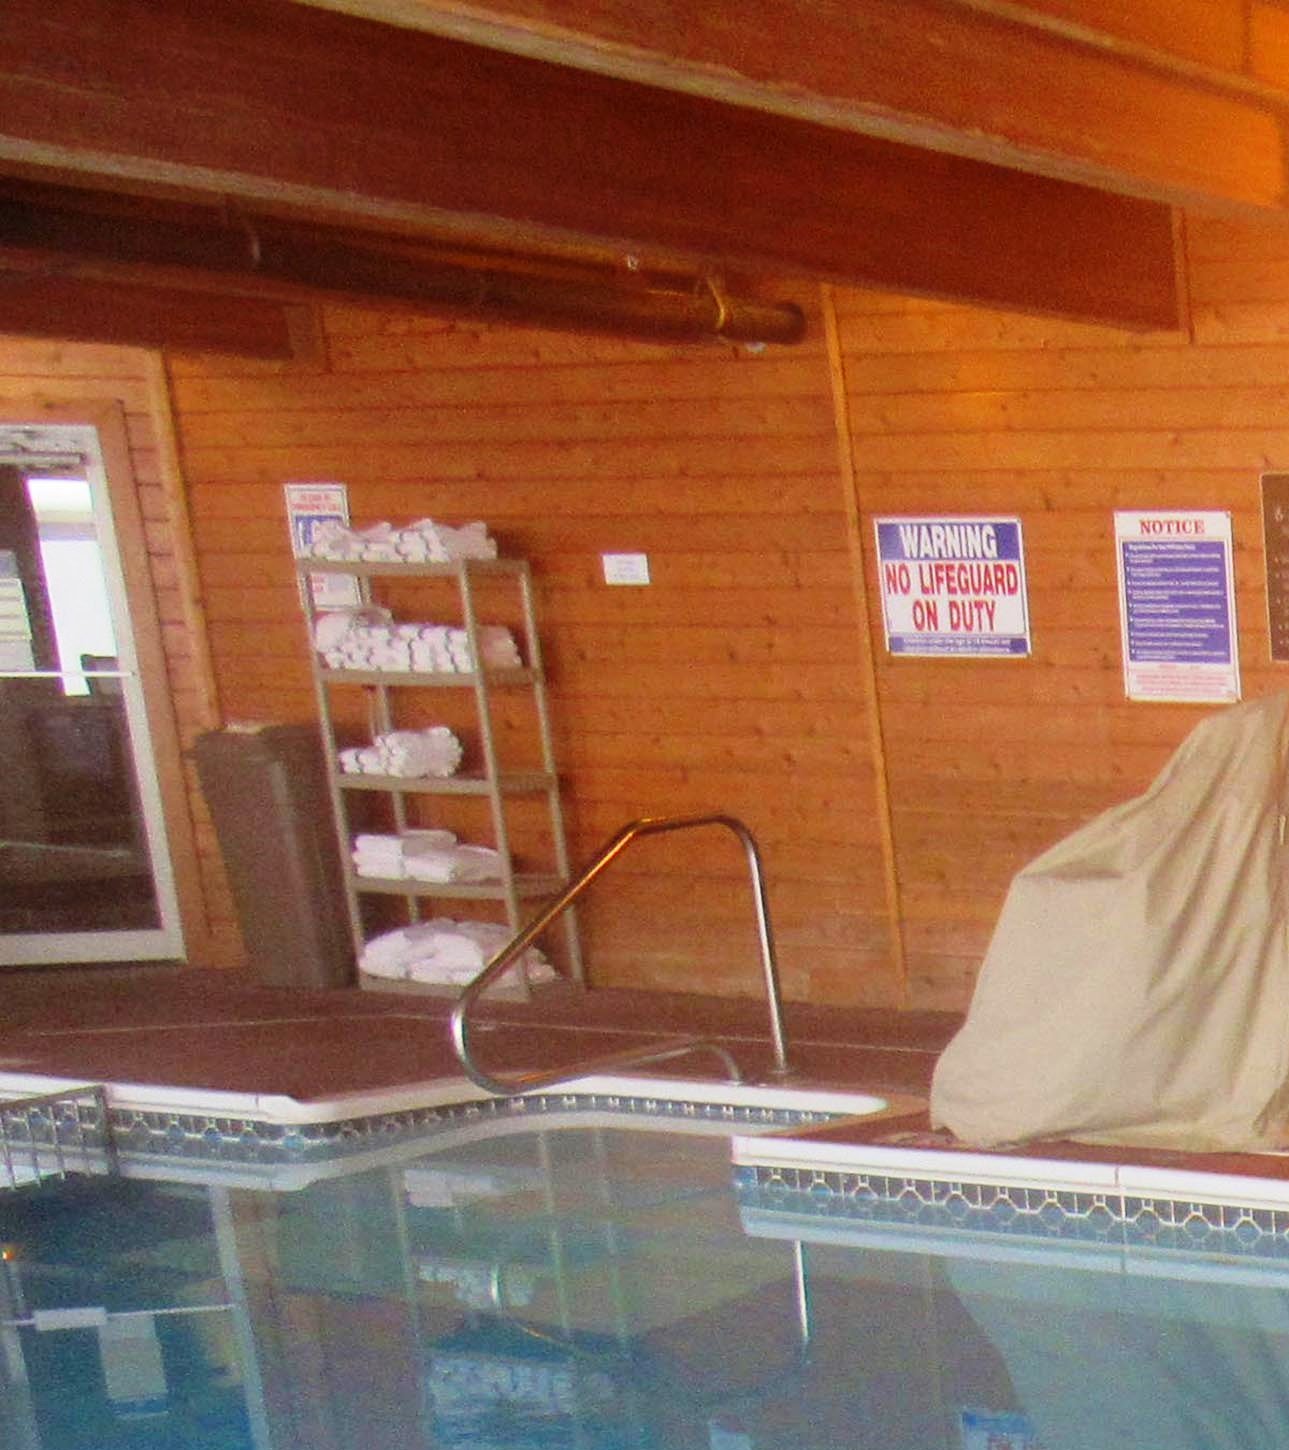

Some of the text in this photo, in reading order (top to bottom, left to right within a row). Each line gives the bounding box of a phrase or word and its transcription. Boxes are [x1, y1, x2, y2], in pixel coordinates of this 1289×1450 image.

[900, 524, 998, 559] WARNING
[1140, 519, 1205, 535] NOTICE
[885, 562, 1019, 596] NO LIFEGUARD
[912, 598, 997, 633] ON DUTY
